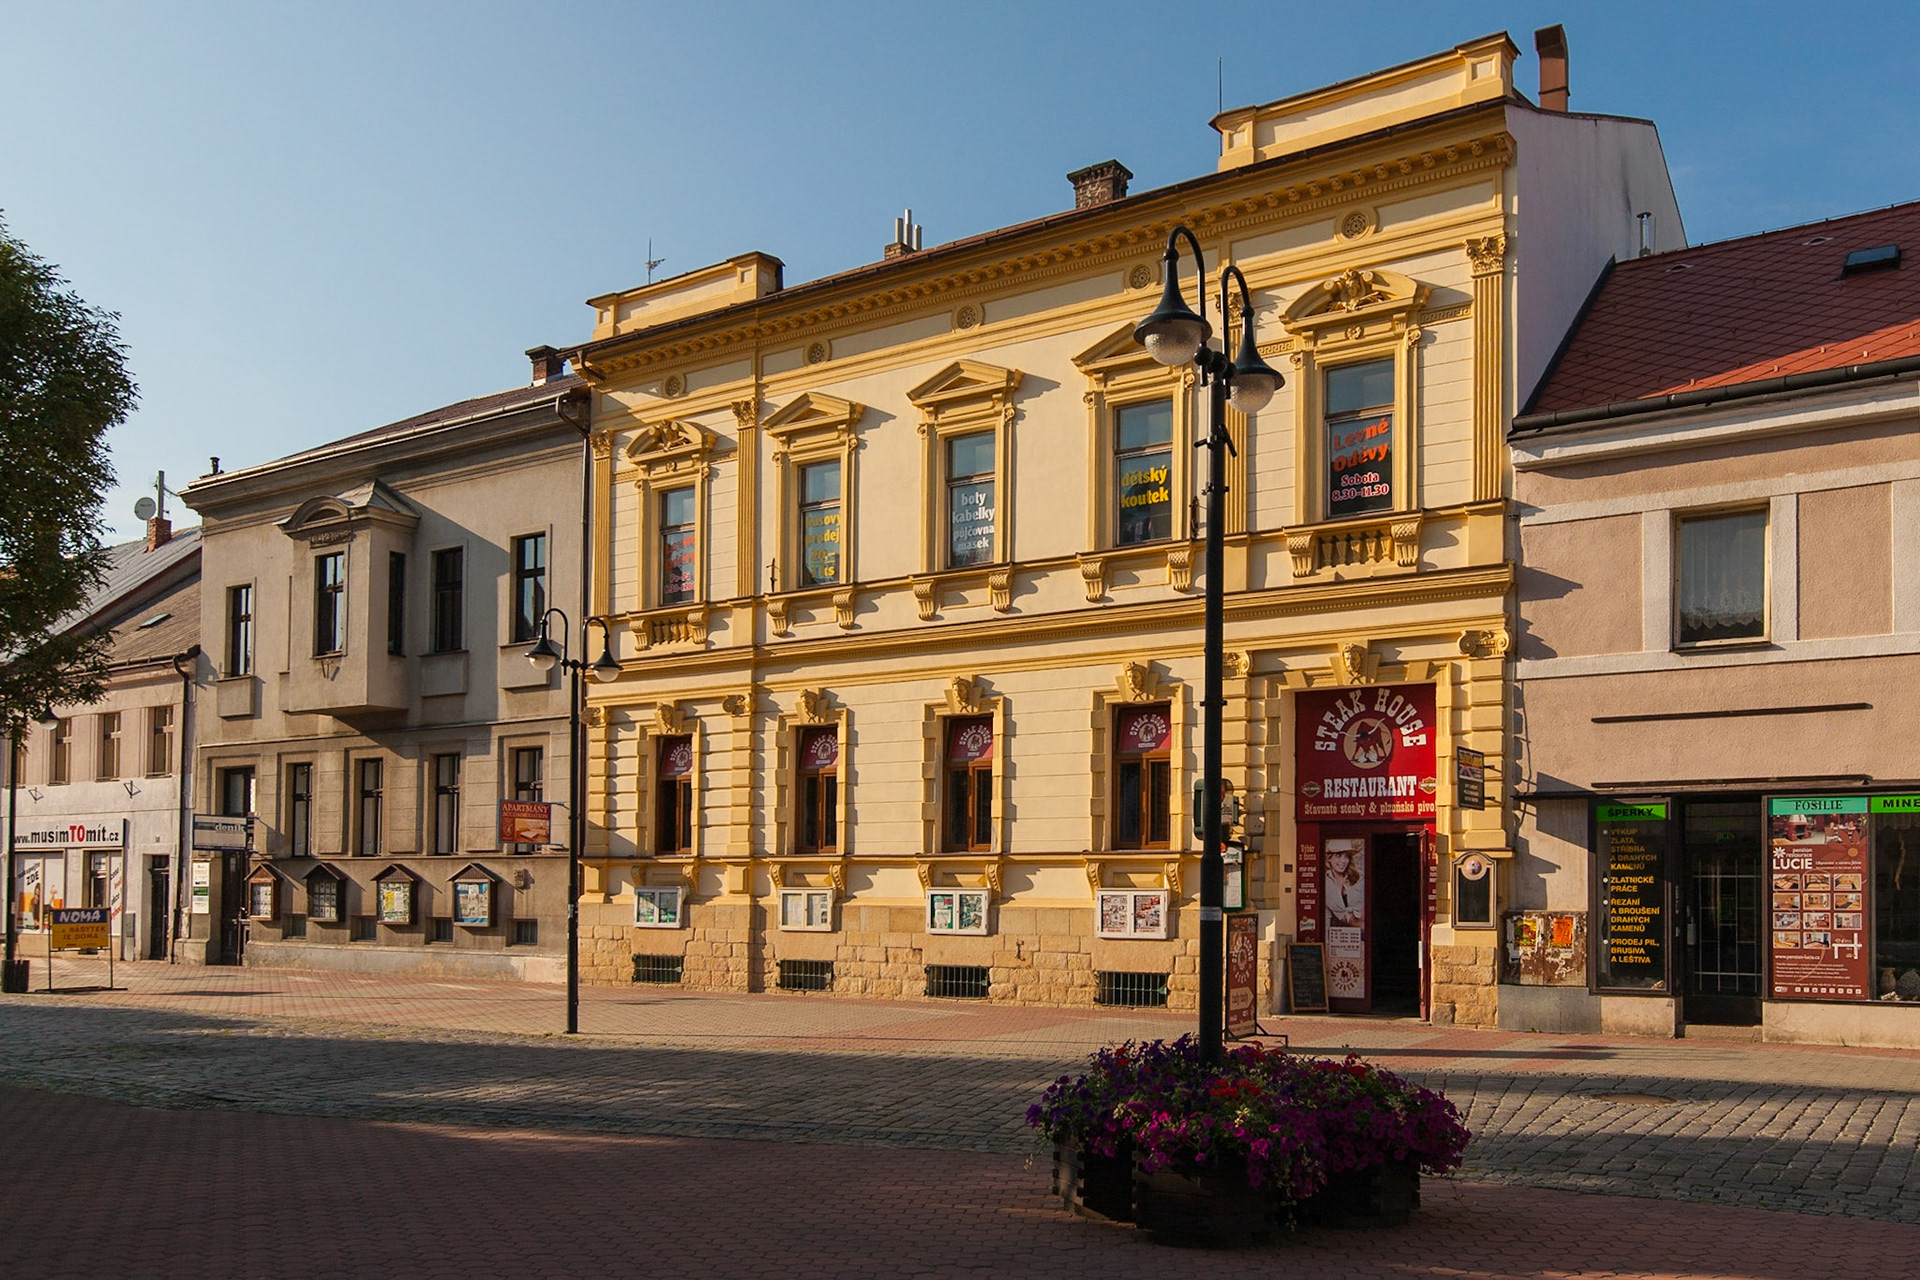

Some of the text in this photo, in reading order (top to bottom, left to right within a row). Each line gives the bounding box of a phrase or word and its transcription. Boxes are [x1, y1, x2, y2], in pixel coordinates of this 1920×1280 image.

[1333, 416, 1389, 451] Levné
[1333, 442, 1389, 472] Oděvy
[1121, 464, 1168, 487] dětský
[1341, 472, 1379, 486] Sobota
[961, 491, 986, 506] boty
[1121, 487, 1169, 508] koutek
[952, 506, 995, 523] kabelky
[805, 528, 840, 547] prodej
[953, 525, 994, 541] půjčovna
[958, 537, 989, 551] masek
[1315, 688, 1427, 751] STEAK HOUSE
[1323, 776, 1417, 798] RESTAURANT
[502, 803, 549, 813] APARTMÁNY
[1304, 801, 1338, 815] Šťavnaté
[1340, 801, 1366, 816] steaky
[1369, 801, 1377, 814] &
[1380, 800, 1415, 816] plzeňské
[1607, 807, 1654, 817] ŠPERKY
[1794, 800, 1843, 811] FOSILIE
[1610, 861, 1645, 870] KAMENŮ
[1773, 858, 1813, 870] LUCIE
[26, 871, 39, 885] ZDE
[1610, 875, 1654, 884] ZLATNICKÉ
[1610, 884, 1638, 893] PRÁCE
[1610, 897, 1641, 906] ŘEZÁNÍ
[59, 910, 101, 922] NOMA
[1618, 906, 1660, 915] BROUŠENÍ
[1610, 915, 1650, 923] DRAHÝCH
[1610, 924, 1645, 932] KAMENŮ
[1610, 938, 1660, 947] PRODEJ PIL,
[1610, 955, 1651, 964] A LEŠTIVA
